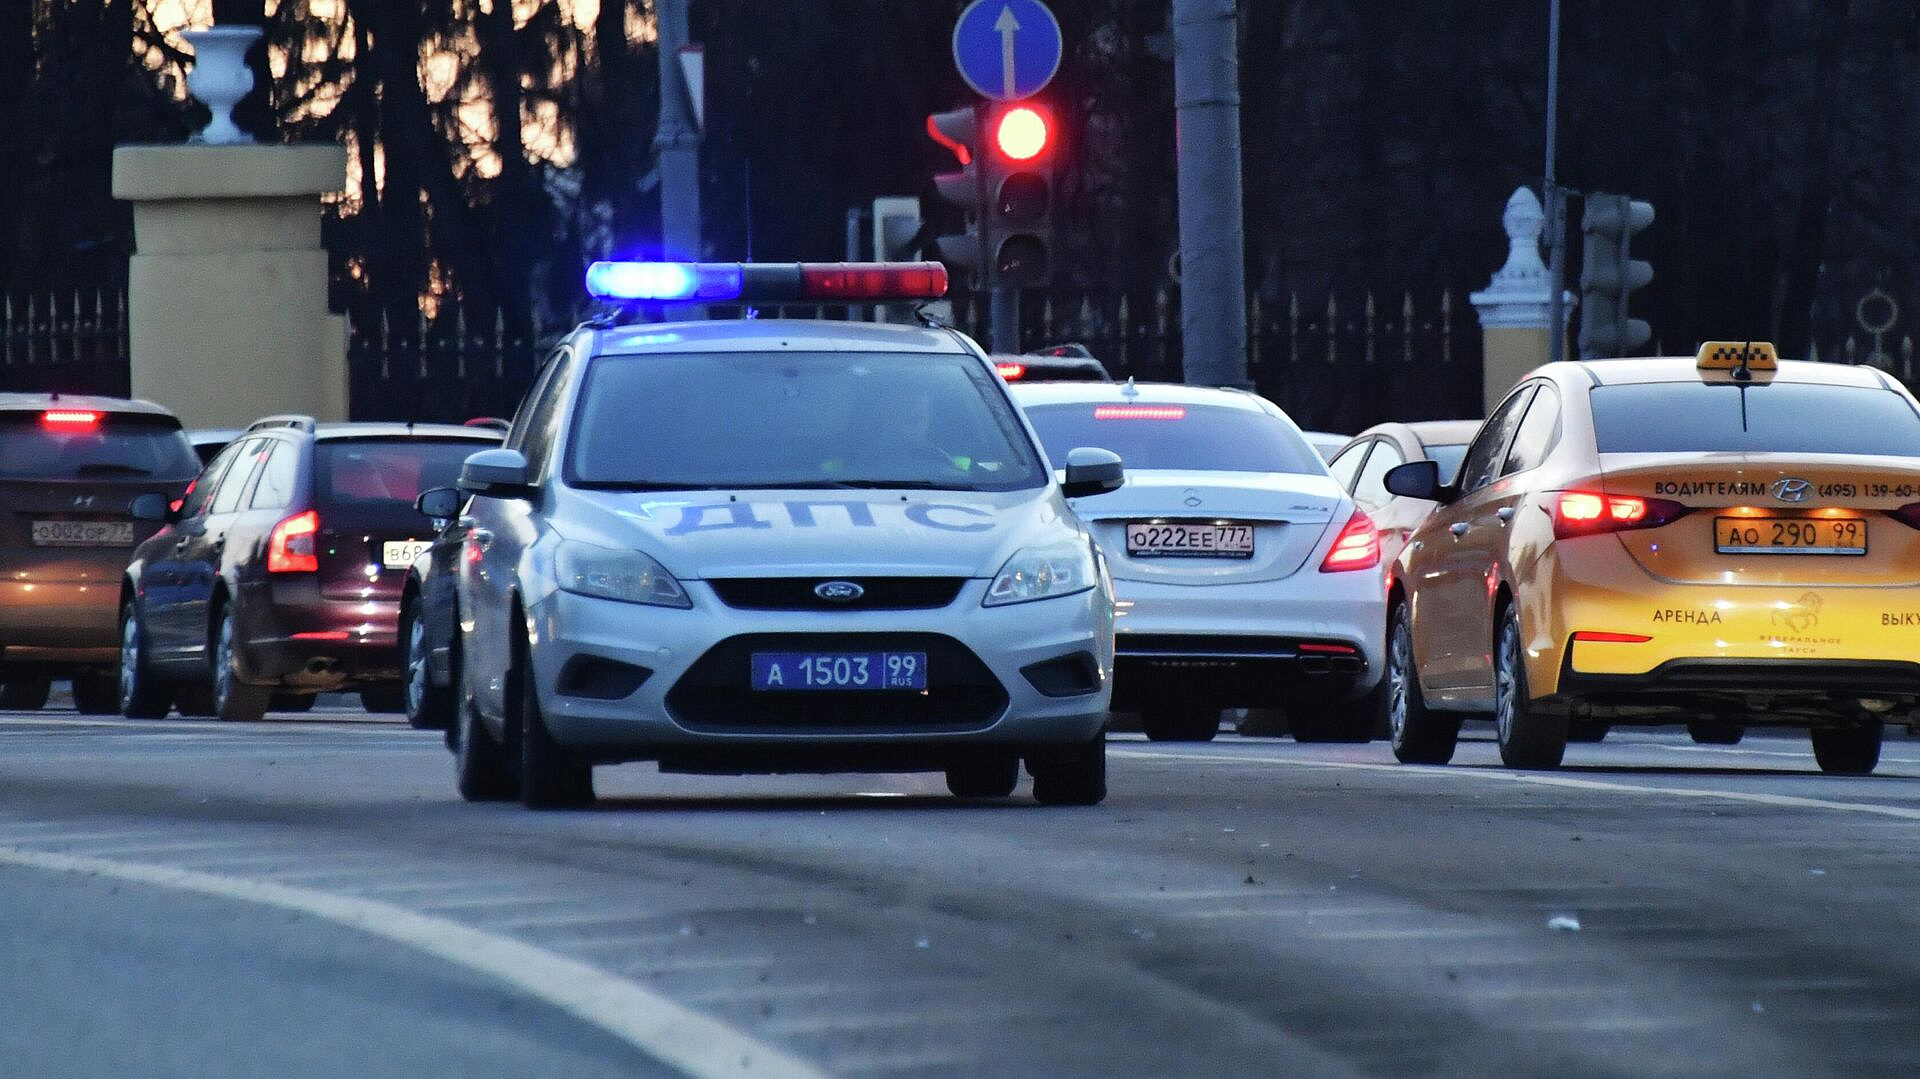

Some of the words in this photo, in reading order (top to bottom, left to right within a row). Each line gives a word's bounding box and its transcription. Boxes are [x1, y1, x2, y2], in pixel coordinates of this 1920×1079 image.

[1655, 481, 1766, 497] ВОДИТЕЛЯМ
[1818, 483, 1857, 498] (495)
[1864, 483, 1920, 498] 139-60-
[663, 501, 996, 536] ДПС
[1134, 527, 1213, 548] О222ЕЕ
[1216, 527, 1247, 543] 777
[1729, 527, 1759, 545] АО
[1771, 522, 1817, 546] 290
[1832, 522, 1857, 540] 99
[1652, 609, 1722, 625] АРЕНДА
[767, 663, 784, 686] А
[798, 656, 870, 686] 1503
[887, 655, 917, 677] 99
[891, 677, 913, 687] RUS
